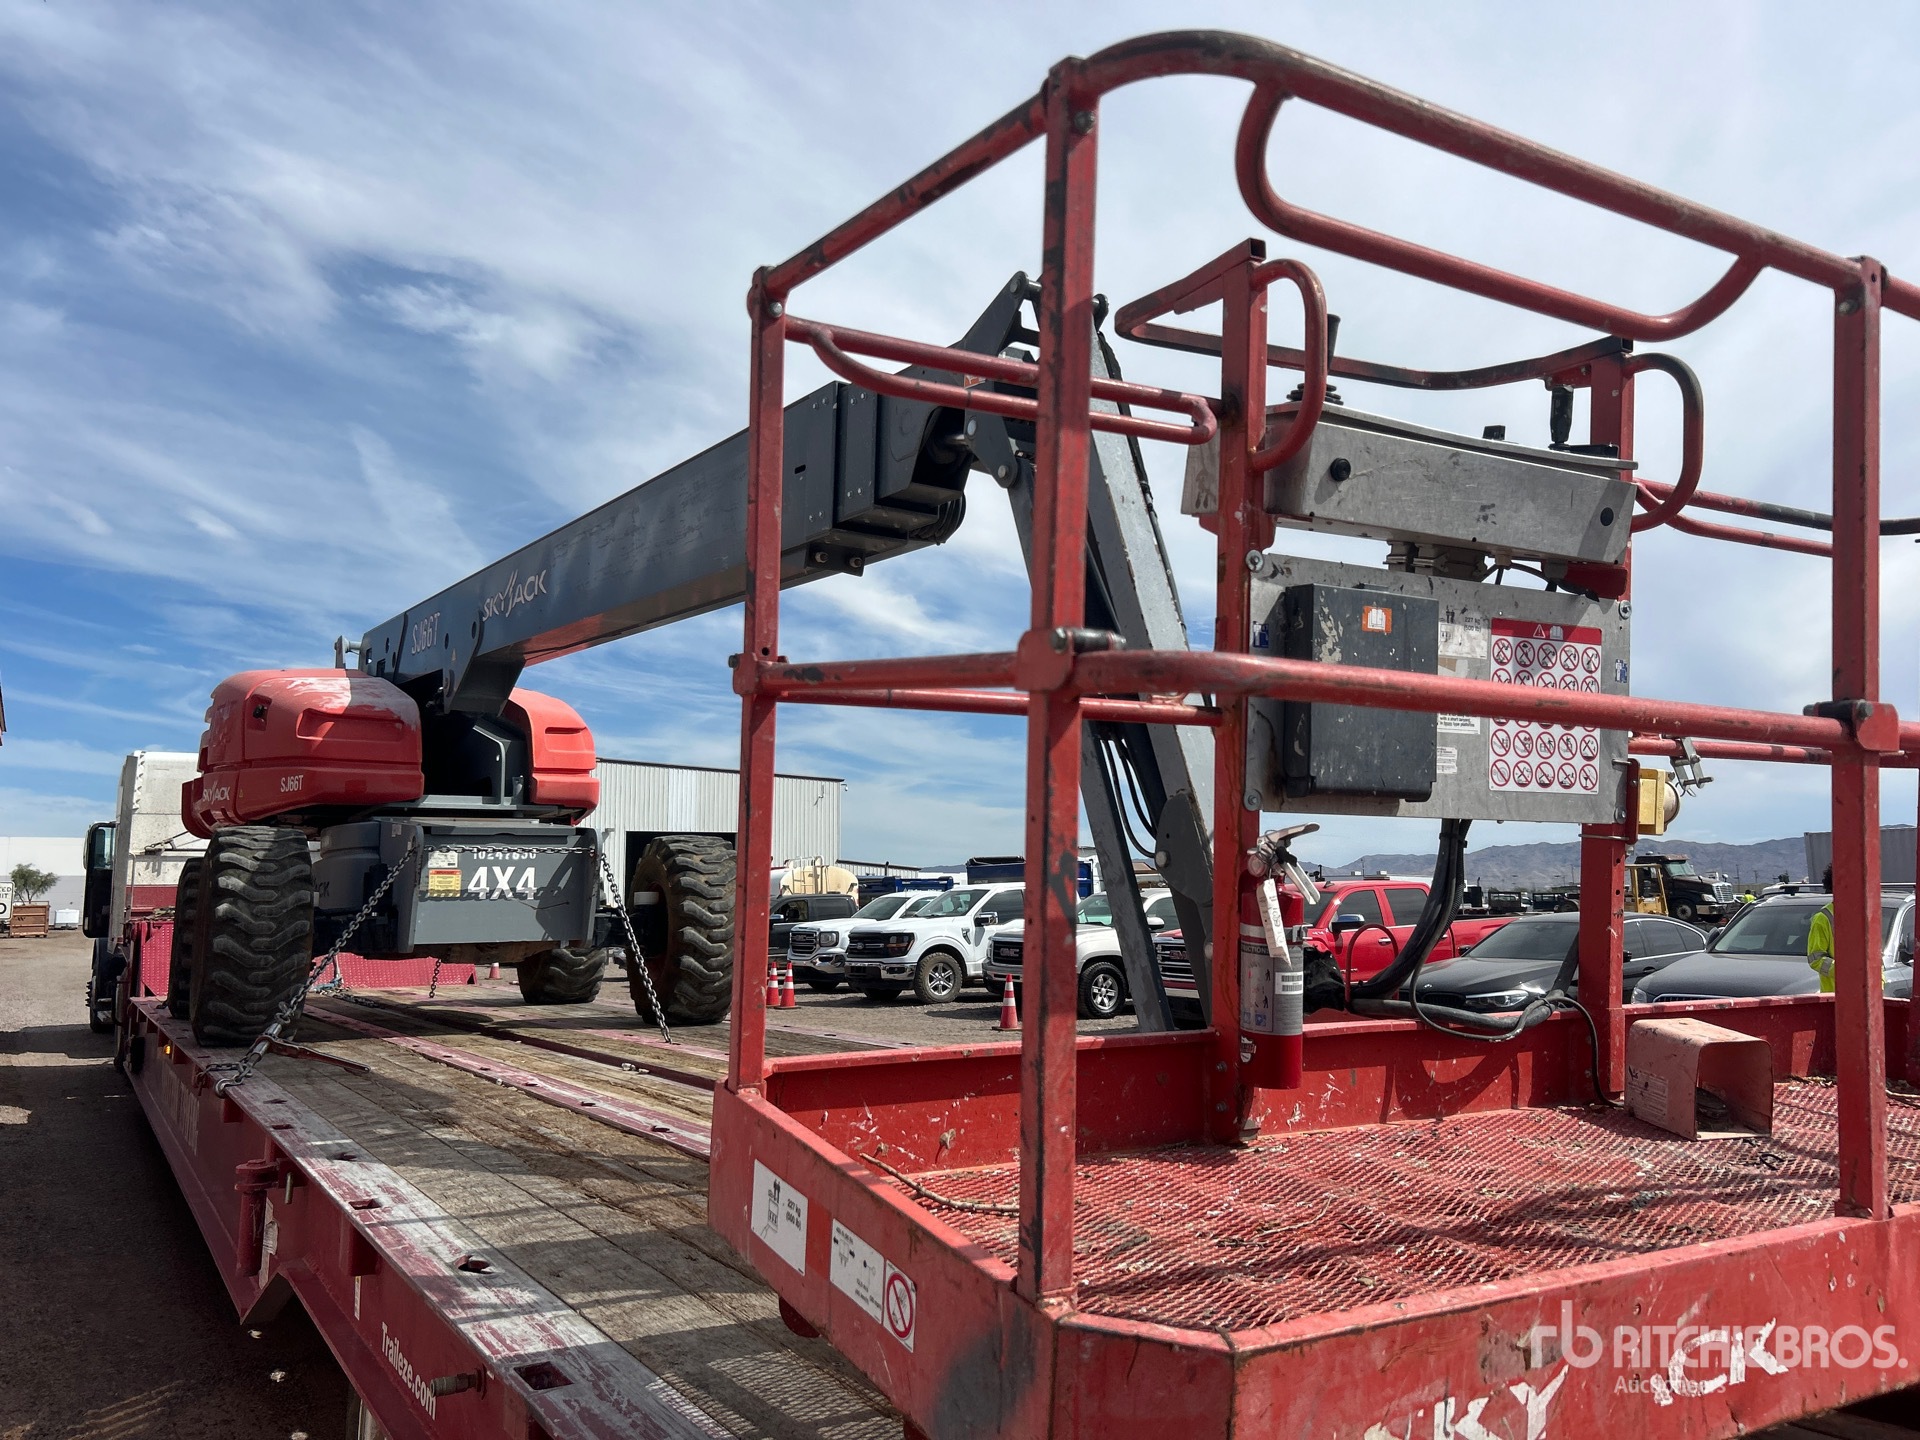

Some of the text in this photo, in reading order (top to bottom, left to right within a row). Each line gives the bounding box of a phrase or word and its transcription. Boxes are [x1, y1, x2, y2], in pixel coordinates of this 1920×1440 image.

[482, 569, 547, 622] SKYJACK
[411, 612, 440, 655] SJ66T
[202, 780, 231, 805] SKYJACK
[280, 775, 304, 792] SJ66T
[467, 866, 538, 900] 4X4
[999, 948, 1020, 957] GMC
[1169, 950, 1188, 959] GM
[381, 1321, 437, 1420] Traileze.com
